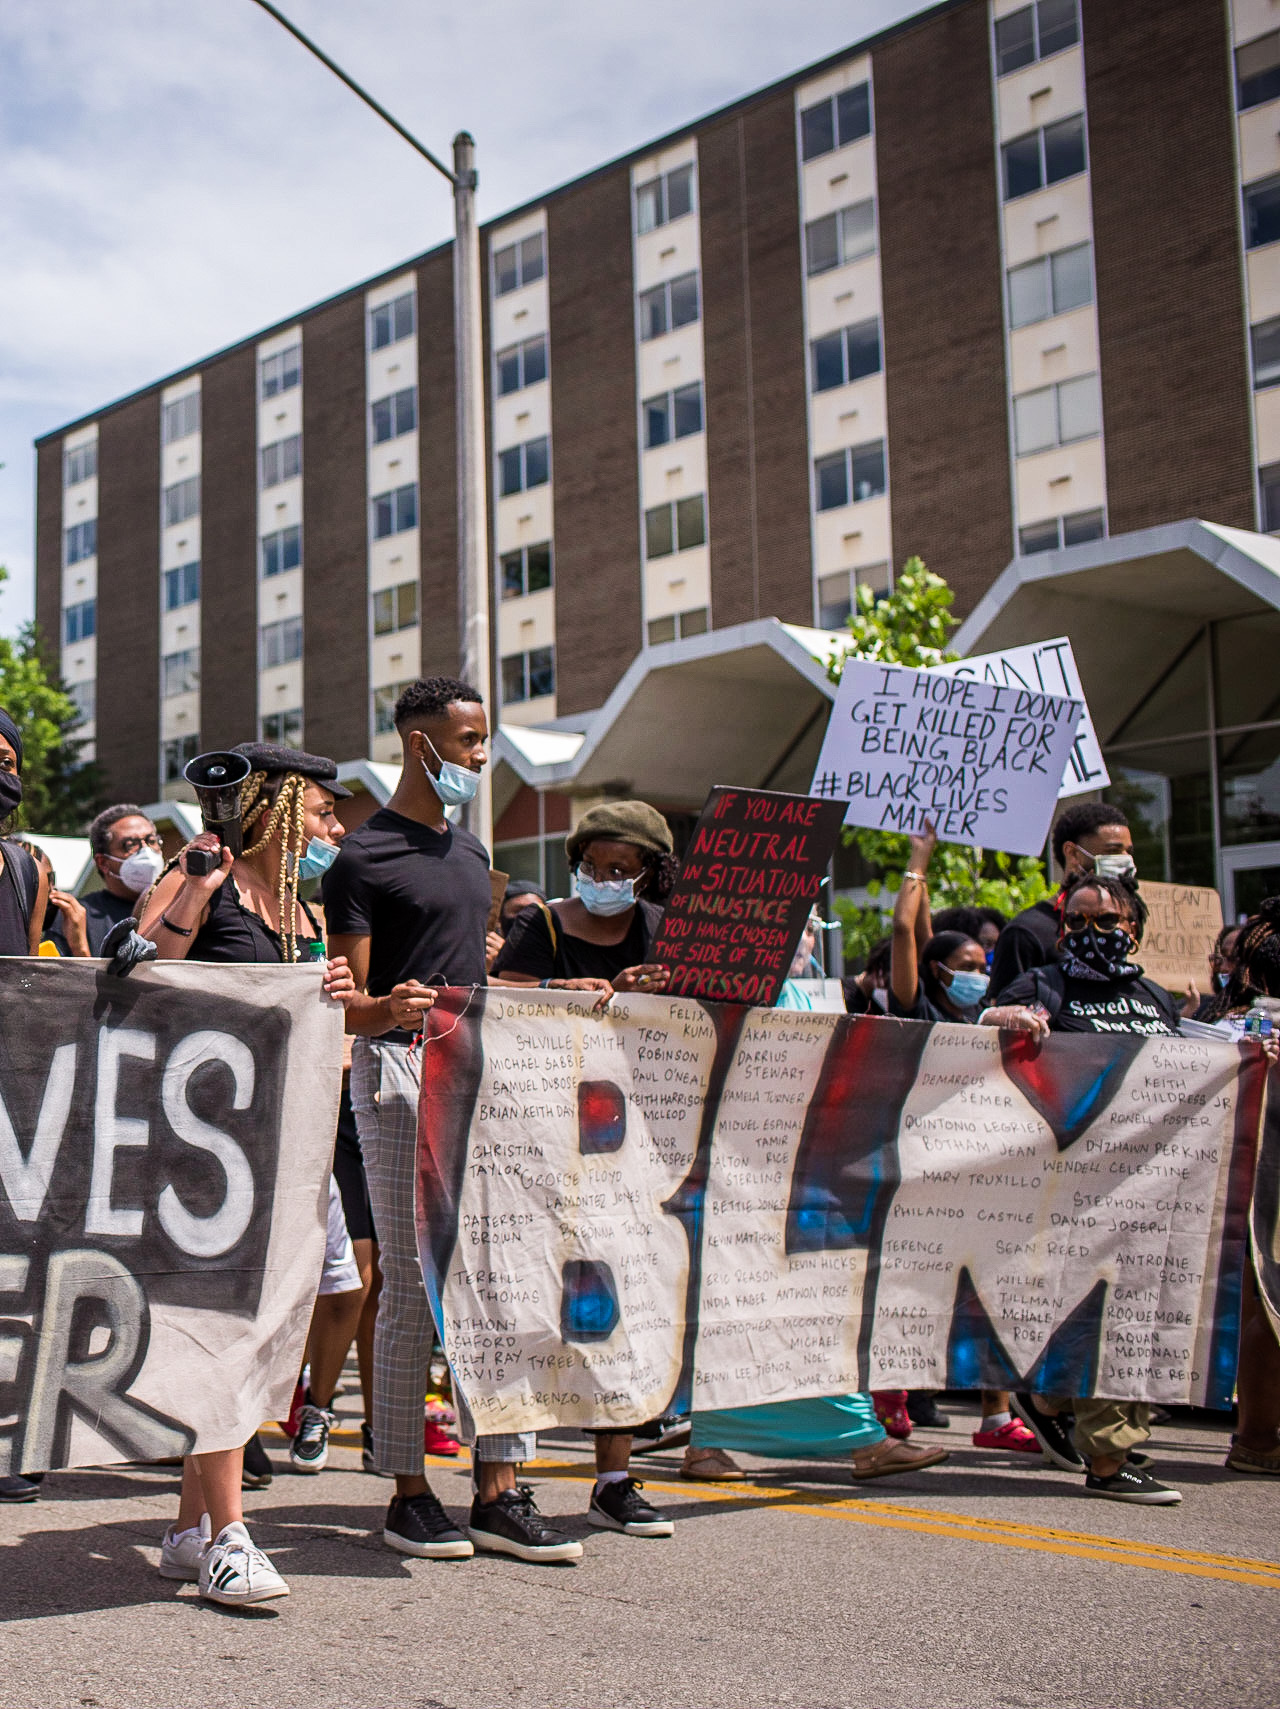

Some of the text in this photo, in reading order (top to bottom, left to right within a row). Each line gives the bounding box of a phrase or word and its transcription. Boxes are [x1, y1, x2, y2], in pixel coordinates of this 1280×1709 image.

[873, 668, 1084, 724] I HOPE I DON'T
[851, 699, 1055, 754] GET KILLED FOR
[861, 726, 948, 761] BEING
[962, 740, 1047, 774] BLACK
[908, 759, 988, 790] TODAY
[815, 770, 1008, 814] #BLACK LIVES
[715, 793, 821, 826] IF YOU ARE
[880, 803, 978, 837] MATTER
[693, 828, 809, 862] NEUTRAL
[683, 863, 821, 898] IN SITUATIONS
[671, 894, 791, 923] OF INJUSTICE
[664, 917, 789, 946] YOU HAVE CHOSEN
[655, 941, 785, 968] THE SIDE OF THE
[497, 1002, 629, 1020] JORDAN EDWARDS
[670, 1004, 705, 1021] FELIX
[1070, 998, 1160, 1018] Saved But
[762, 1012, 835, 1027] ERIC HARRIS
[1091, 1018, 1171, 1034] Not Soft
[638, 1028, 668, 1043] TROY
[683, 1024, 712, 1039] KUMI
[744, 1028, 771, 1042] AKAI
[583, 1036, 624, 1049] SMITH
[972, 1034, 999, 1052] FORD
[1159, 1043, 1208, 1056] AARON
[638, 1047, 698, 1062] ROBINSON
[738, 1050, 788, 1066] DARRIUS
[490, 1056, 584, 1072] MICHAEL SABBIE
[1153, 1055, 1211, 1073] BAILEY
[633, 1069, 658, 1083] PAUL
[745, 1065, 805, 1080] STEWART
[922, 1073, 985, 1087] DEMARCUS
[493, 1080, 538, 1095] SAMUEL
[1144, 1076, 1186, 1089] KEITH
[630, 1093, 658, 1104] KEITH
[960, 1090, 1013, 1107] SEMER
[1131, 1089, 1231, 1109] CHILDRESS JR
[480, 1104, 575, 1121] BRIAN KEITH DAY
[1110, 1112, 1212, 1127] RONELL FOSTER
[905, 1114, 976, 1133] QUINTONIO
[756, 1135, 788, 1148] TAMIR
[922, 1136, 1036, 1157] BOTHAM JEAN
[472, 1145, 543, 1159] CHRISTIAN
[766, 1152, 789, 1164] RICE
[1155, 1144, 1218, 1163] PERKINS
[714, 1155, 749, 1168] ALTON
[1043, 1159, 1191, 1179] WENDELL CELESTINE
[469, 1164, 521, 1178] TAYLOR
[589, 1169, 622, 1183] FLOYD
[726, 1172, 783, 1186] STERLING
[922, 1170, 1041, 1189] MARY TRUXILLO
[712, 1200, 752, 1215] BETTIE
[1073, 1191, 1206, 1215] STEPHON CLARK
[894, 1204, 1034, 1223] PHILANDO CASTILE
[464, 1213, 533, 1230] PATERSON
[1050, 1212, 1168, 1234] DAVID JOSEPH
[470, 1231, 521, 1245] BROWN
[885, 1239, 944, 1255] TERENCE
[996, 1239, 1090, 1258] SEAN REED
[789, 1257, 857, 1272] KEVIN HICKS
[885, 1258, 954, 1273] CRUTCHER
[1115, 1253, 1189, 1269] ANTRONIE
[453, 1271, 524, 1285] TERRILL
[996, 1275, 1045, 1288] WILLIE
[1159, 1270, 1202, 1284] SCOTT
[477, 1289, 540, 1303] THOMAS
[776, 1287, 848, 1303] ANTWON ROSE
[999, 1292, 1064, 1309] TILLMAN
[703, 1298, 731, 1311] INDIA
[878, 1306, 928, 1318] MARCO
[1107, 1306, 1193, 1326] ROQUEMORE
[445, 1318, 517, 1331] ANTHONY
[902, 1324, 935, 1337] LOUD
[1014, 1326, 1045, 1342] ROSE
[1107, 1332, 1160, 1344] LAQUAN
[445, 1336, 515, 1349] ASHFORD
[790, 1336, 840, 1350] MICHAEL
[450, 1350, 522, 1364] BILLY RAY
[803, 1352, 831, 1365] NOEL
[872, 1345, 922, 1357] RUMAIN
[528, 1355, 575, 1370] TYREE
[878, 1357, 937, 1370] BRISBON
[735, 1368, 751, 1379] LEE
[1109, 1367, 1200, 1381] JERAME REID
[520, 1392, 580, 1406] LORENZO
